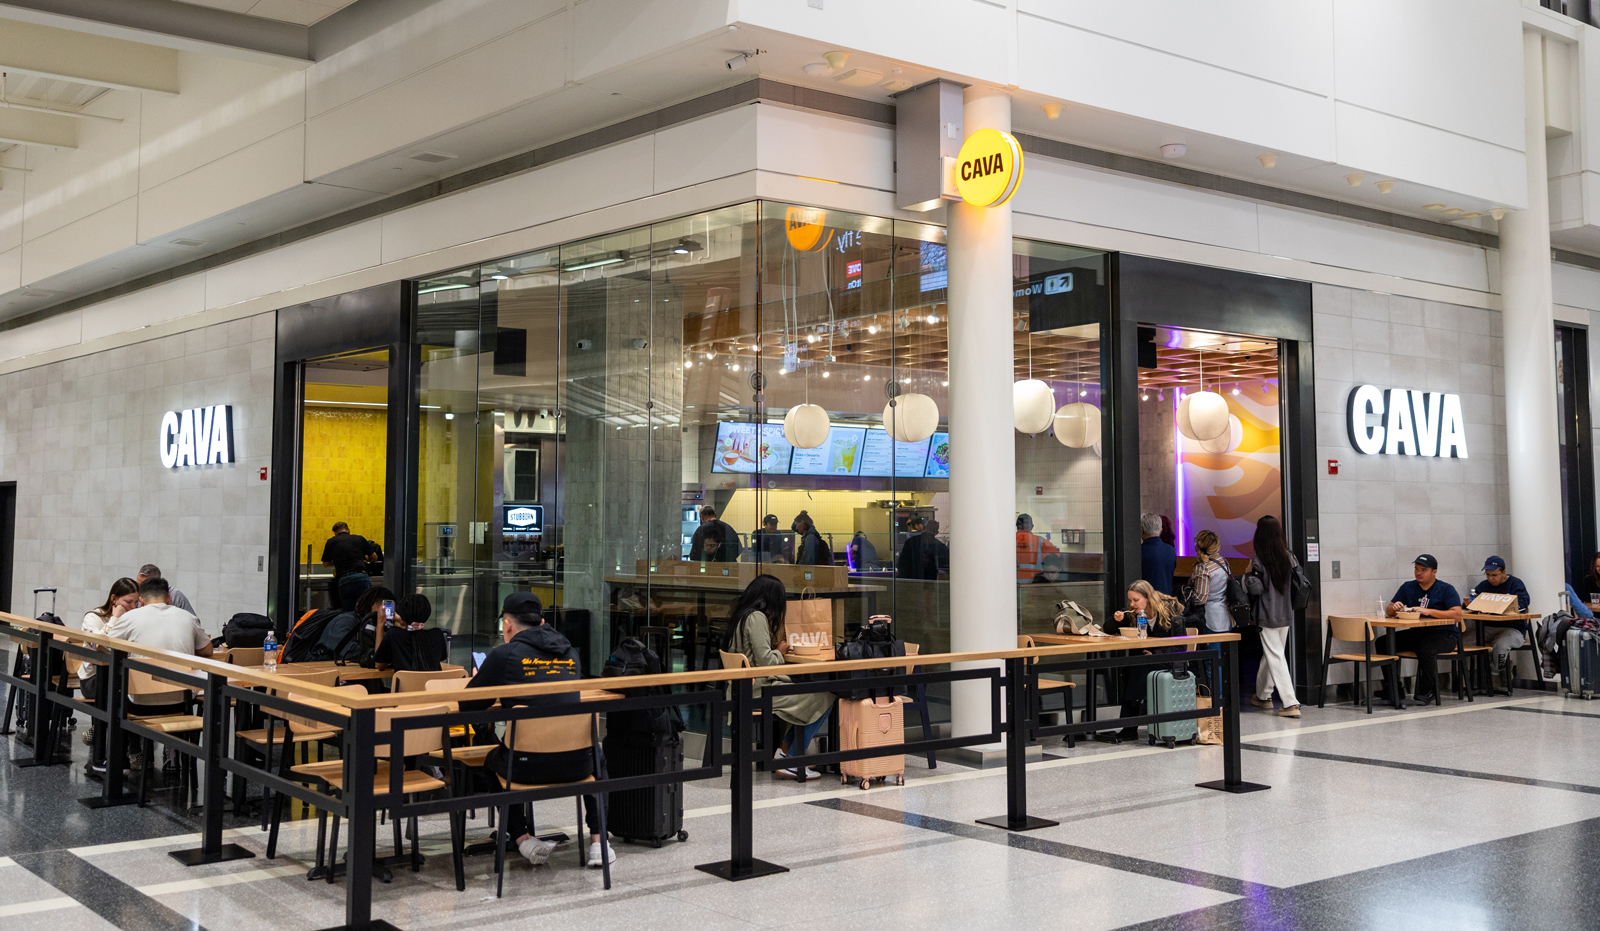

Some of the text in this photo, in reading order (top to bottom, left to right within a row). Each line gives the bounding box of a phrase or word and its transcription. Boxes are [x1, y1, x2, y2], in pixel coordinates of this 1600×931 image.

[961, 152, 1004, 181] CAVA
[728, 425, 755, 434] SWEET
[1348, 384, 1468, 458] CAVA
[160, 404, 232, 468] CAVA
[735, 462, 769, 470] CHICN
[1480, 594, 1512, 602] CAVA
[789, 631, 829, 646] CAVA
[1214, 715, 1222, 740] licious
